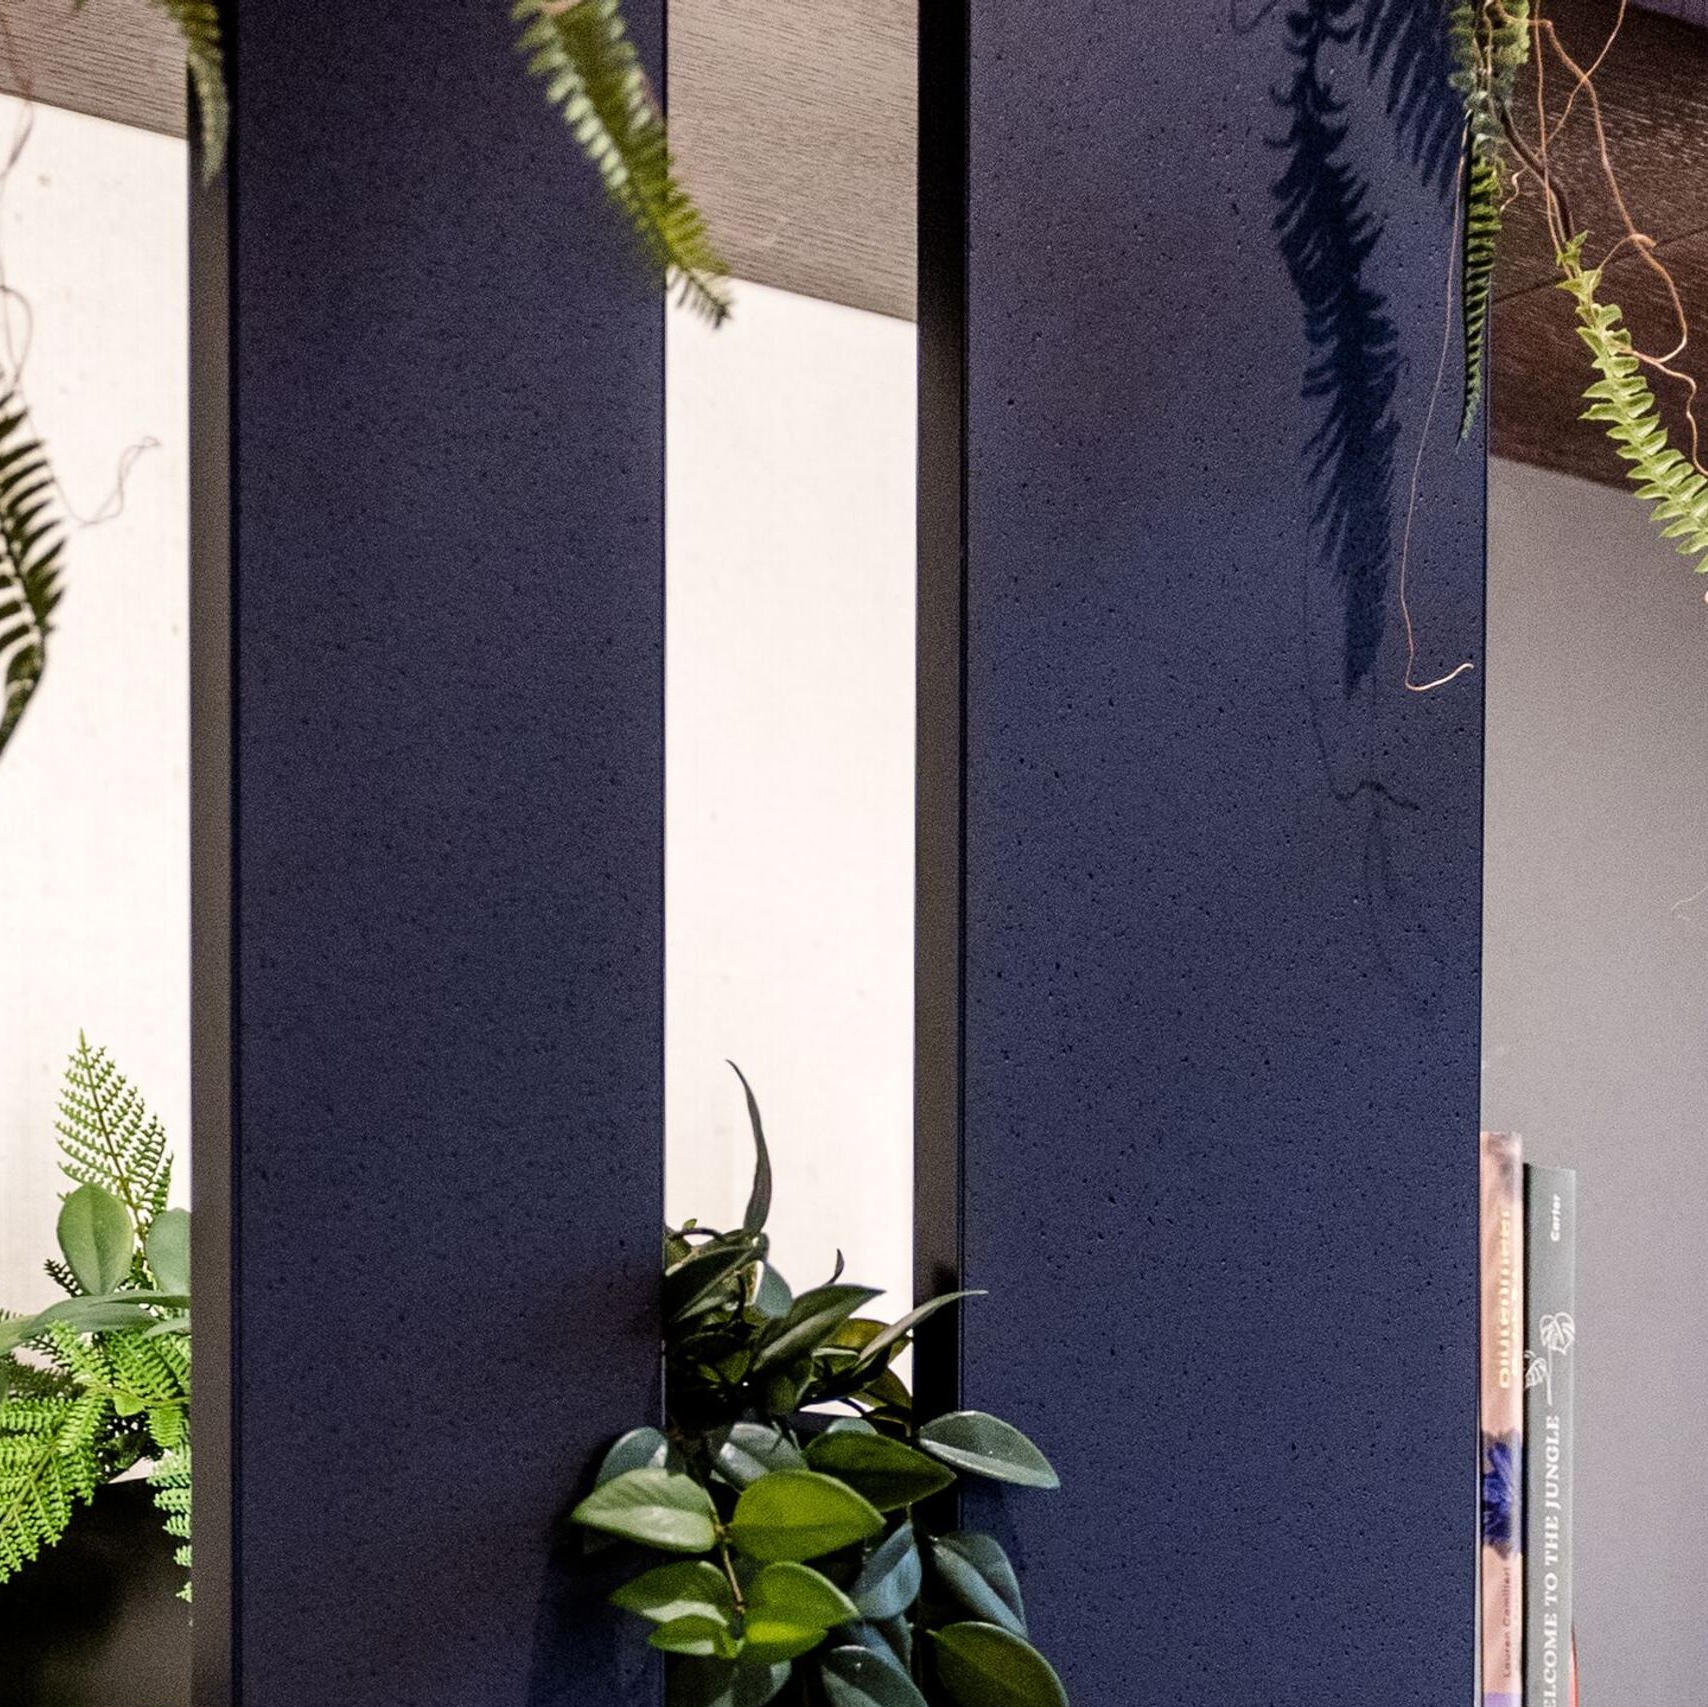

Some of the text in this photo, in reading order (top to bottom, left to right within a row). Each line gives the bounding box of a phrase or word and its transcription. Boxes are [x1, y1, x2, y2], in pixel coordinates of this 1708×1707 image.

[1544, 1414, 1560, 1512] JUNGLE
[1543, 1515, 1560, 1567] THE
[1543, 1572, 1560, 1607] TO
